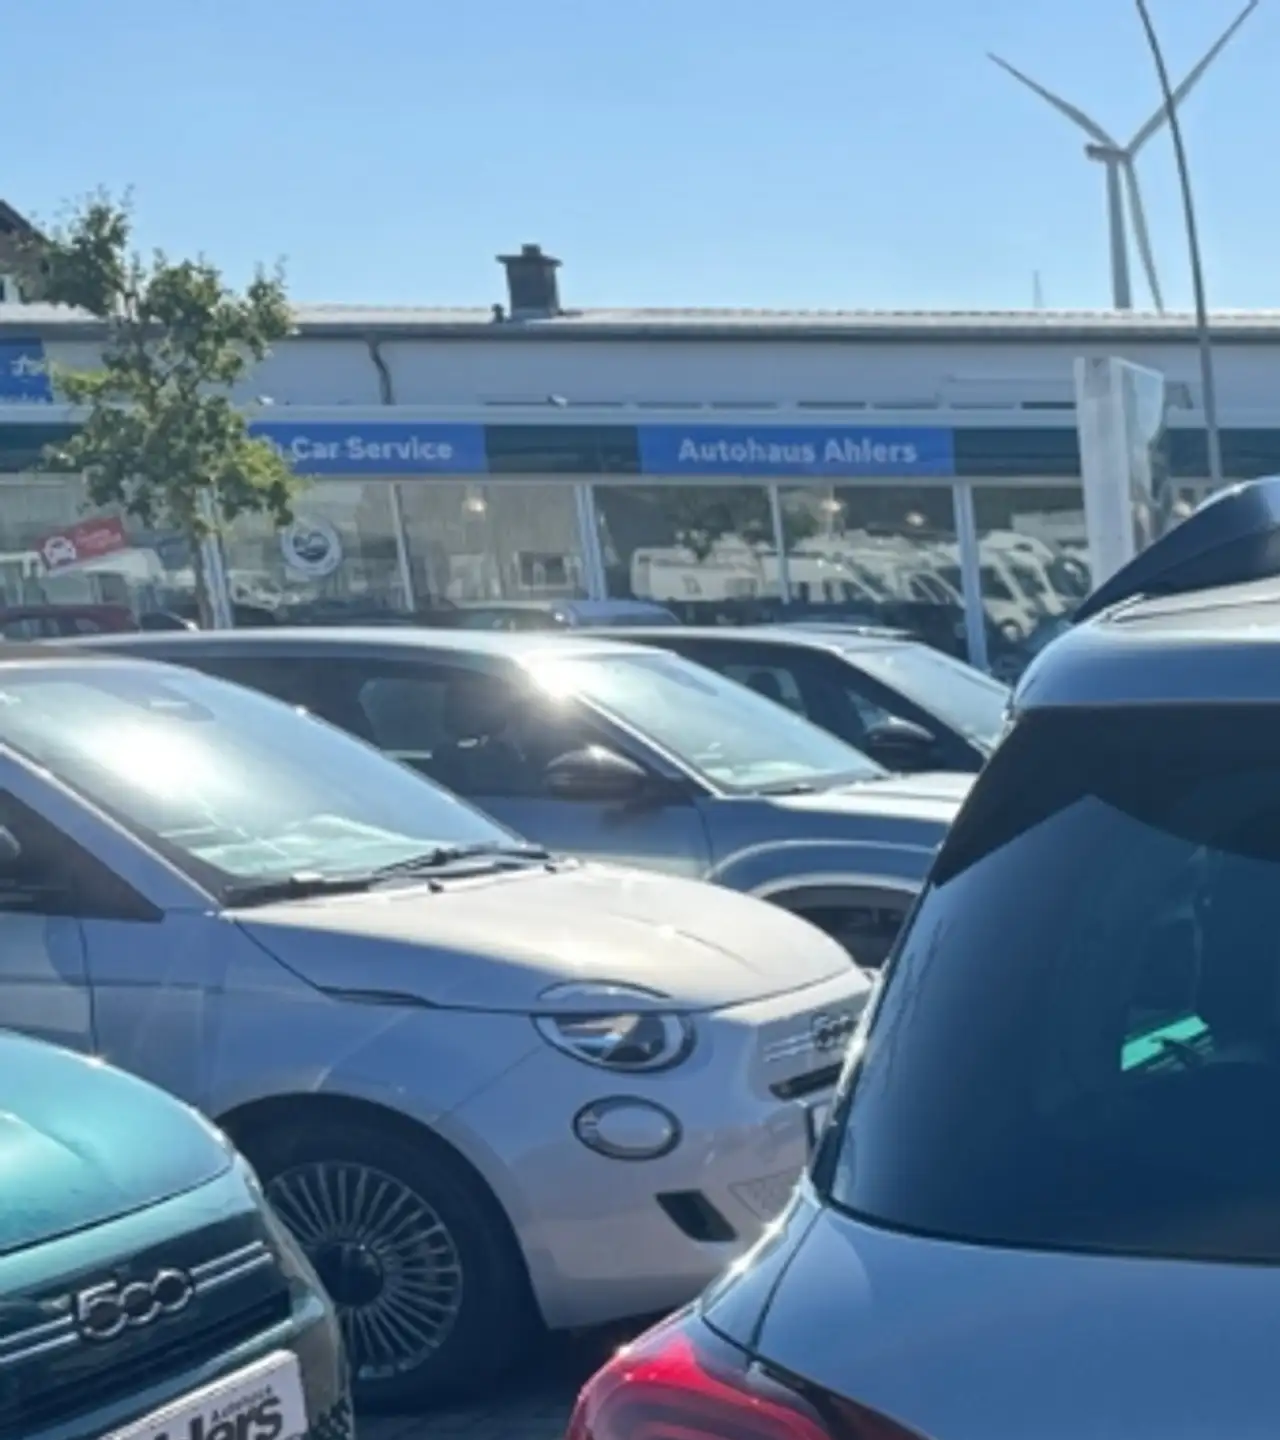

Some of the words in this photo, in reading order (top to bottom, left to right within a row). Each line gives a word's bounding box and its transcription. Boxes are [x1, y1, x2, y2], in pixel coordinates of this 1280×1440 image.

[291, 436, 339, 461] Car
[345, 435, 453, 461] Service
[678, 437, 816, 463] Autohaus
[824, 436, 918, 463] Ahlers
[78, 1267, 193, 1338] 500
